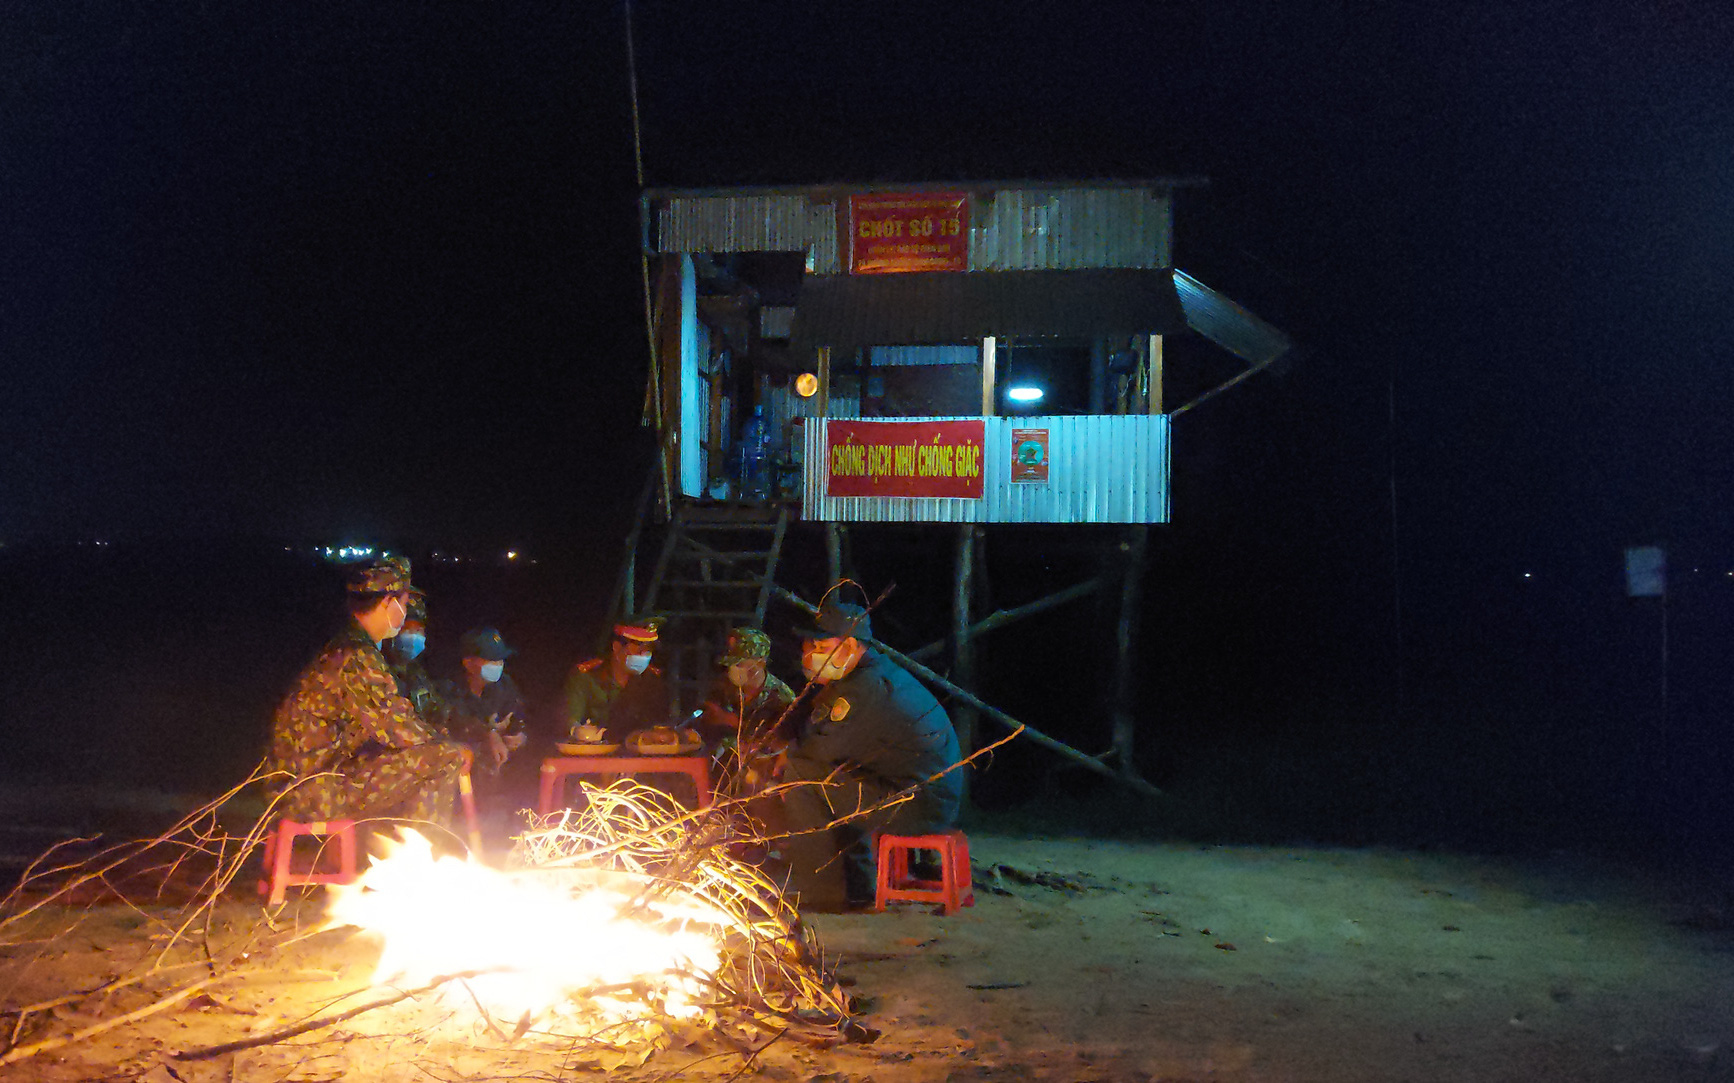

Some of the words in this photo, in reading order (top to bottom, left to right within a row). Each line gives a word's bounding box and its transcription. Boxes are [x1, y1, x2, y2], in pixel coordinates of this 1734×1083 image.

[859, 215, 904, 238] CHỐT
[909, 215, 933, 237] SỐ
[831, 432, 865, 477] CHỐNG
[867, 444, 892, 484] DỊCH
[894, 439, 917, 477] NHƯ
[918, 432, 953, 477] CHỐNG
[955, 439, 980, 487] GIẶC
